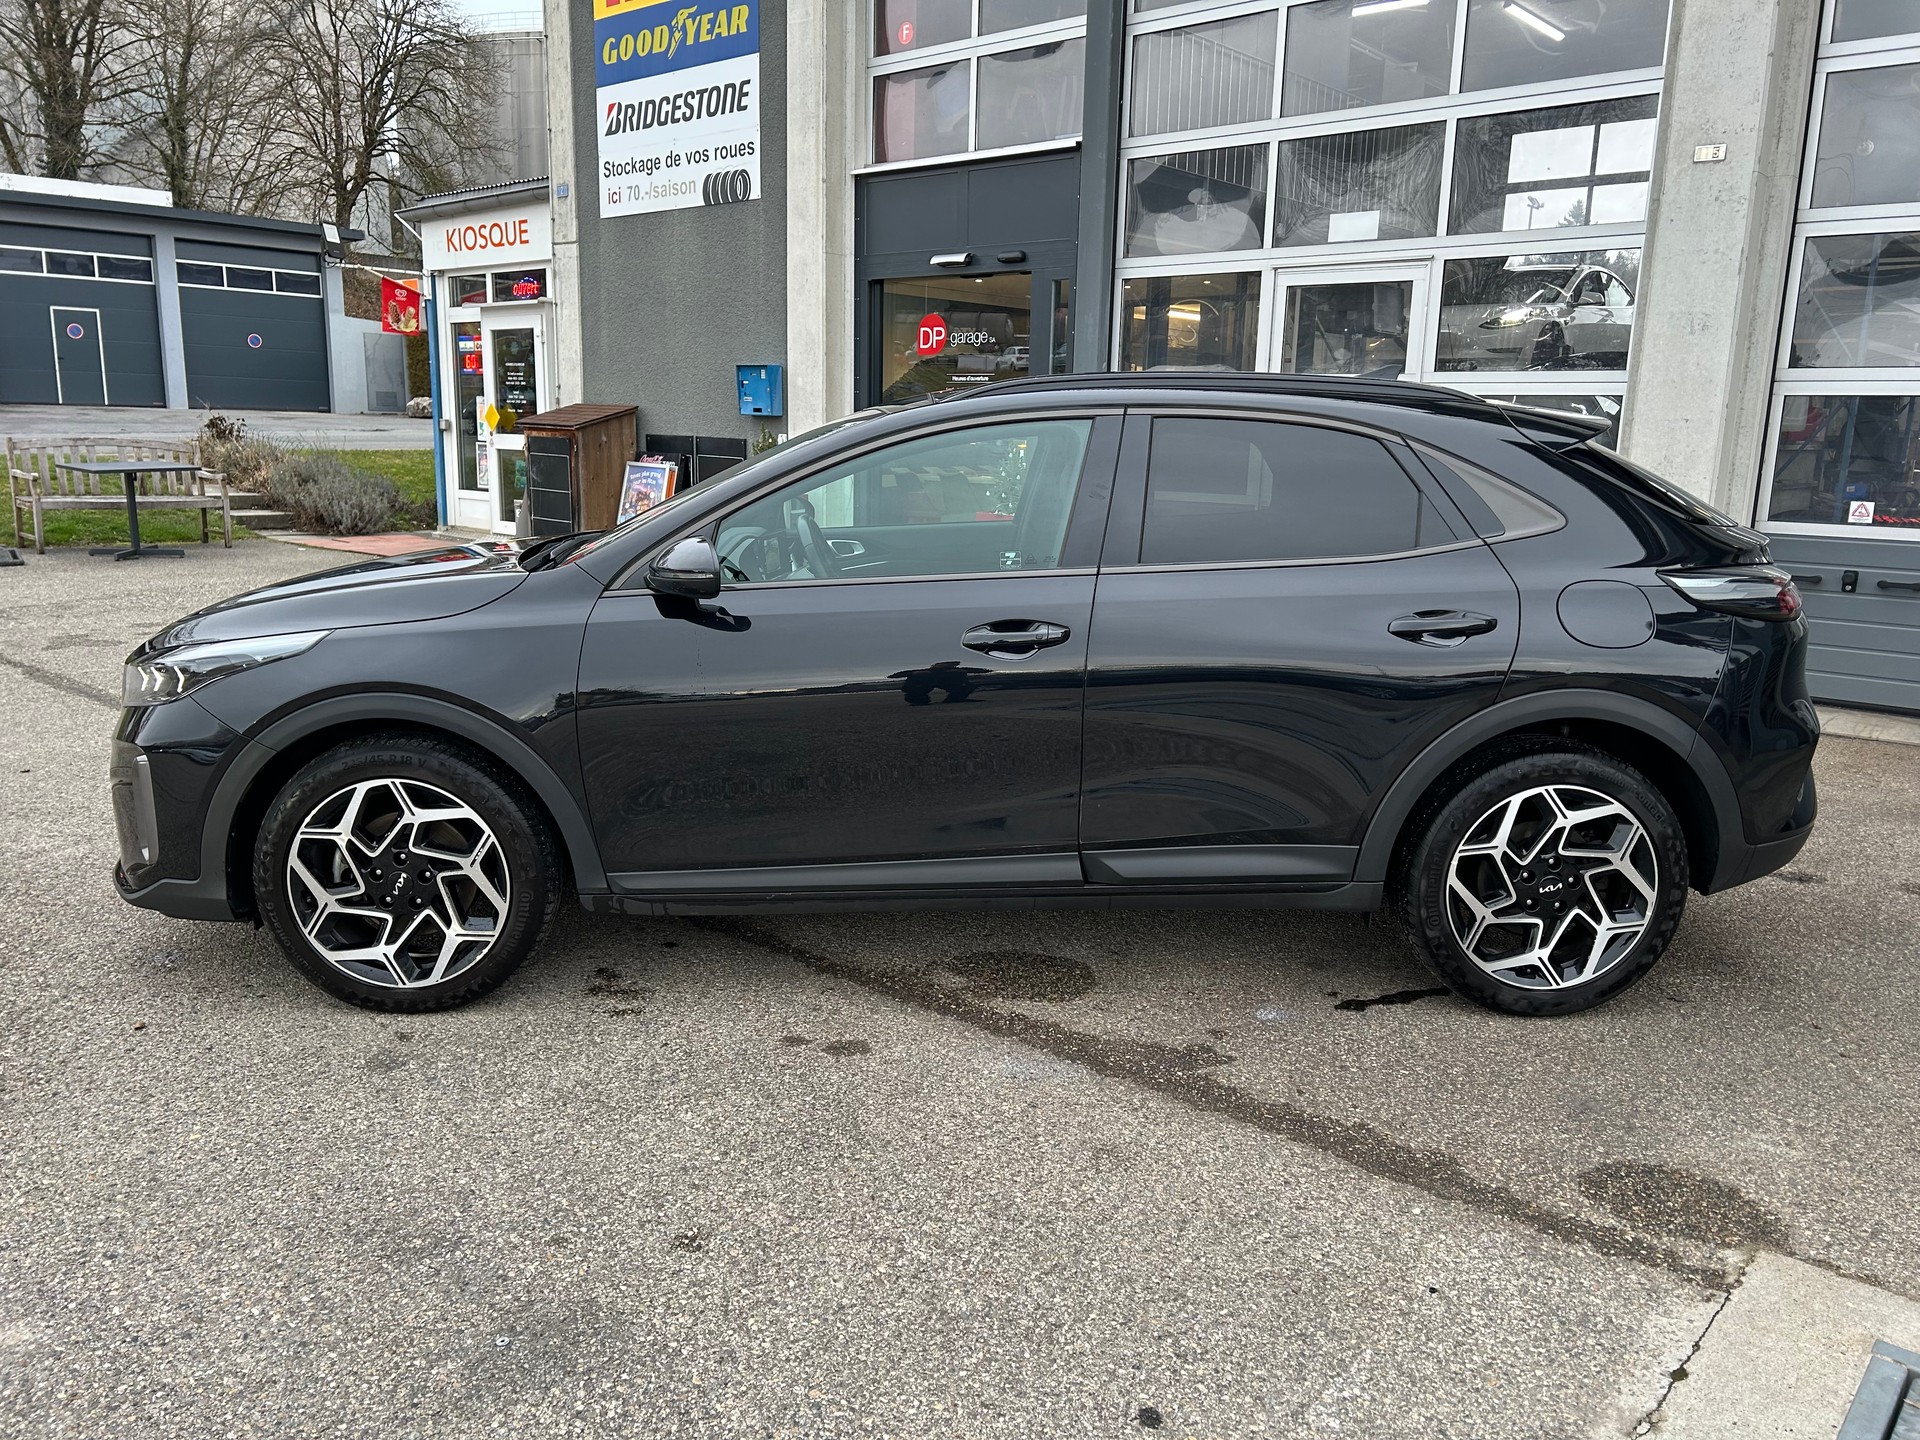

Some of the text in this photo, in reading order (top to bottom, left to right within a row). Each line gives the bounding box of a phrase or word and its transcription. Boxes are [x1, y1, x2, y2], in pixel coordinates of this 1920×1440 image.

[903, 24, 910, 41] F
[604, 79, 751, 136] BRIDGESTONE
[603, 141, 755, 178] Stockage de vos roues
[608, 186, 621, 204] ici
[446, 219, 529, 253] KIOSQUE
[919, 326, 945, 349] DP
[950, 332, 988, 347] garage
